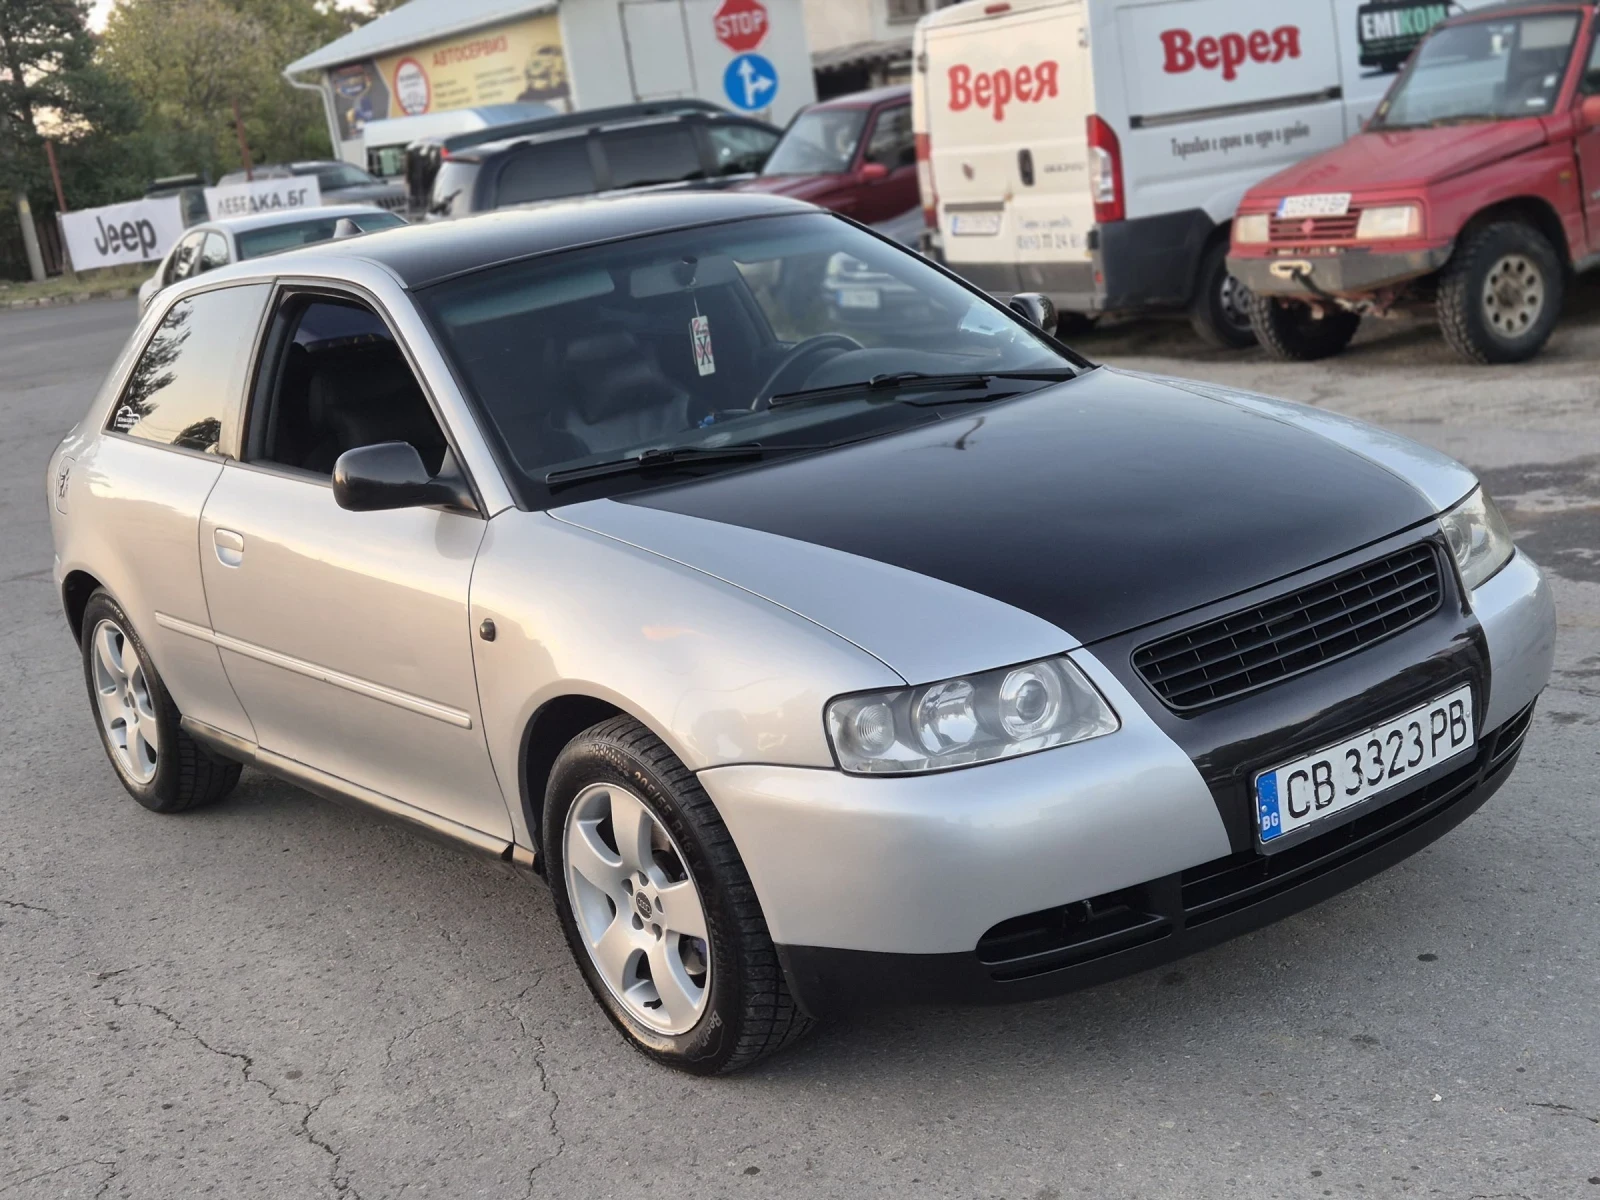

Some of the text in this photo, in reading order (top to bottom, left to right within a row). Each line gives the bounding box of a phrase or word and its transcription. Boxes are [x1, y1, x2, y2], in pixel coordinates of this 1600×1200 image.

[715, 9, 766, 40] STOP
[1361, 4, 1447, 42] EMIKOM
[432, 36, 508, 68] АВТОСЕРВИЗ
[1160, 25, 1302, 81] Верея
[948, 60, 1059, 122] Верея
[94, 215, 157, 259] Jeep
[1287, 699, 1467, 819] CB 3323 PB
[634, 770, 673, 817] 205/55
[1262, 812, 1280, 831] BG
